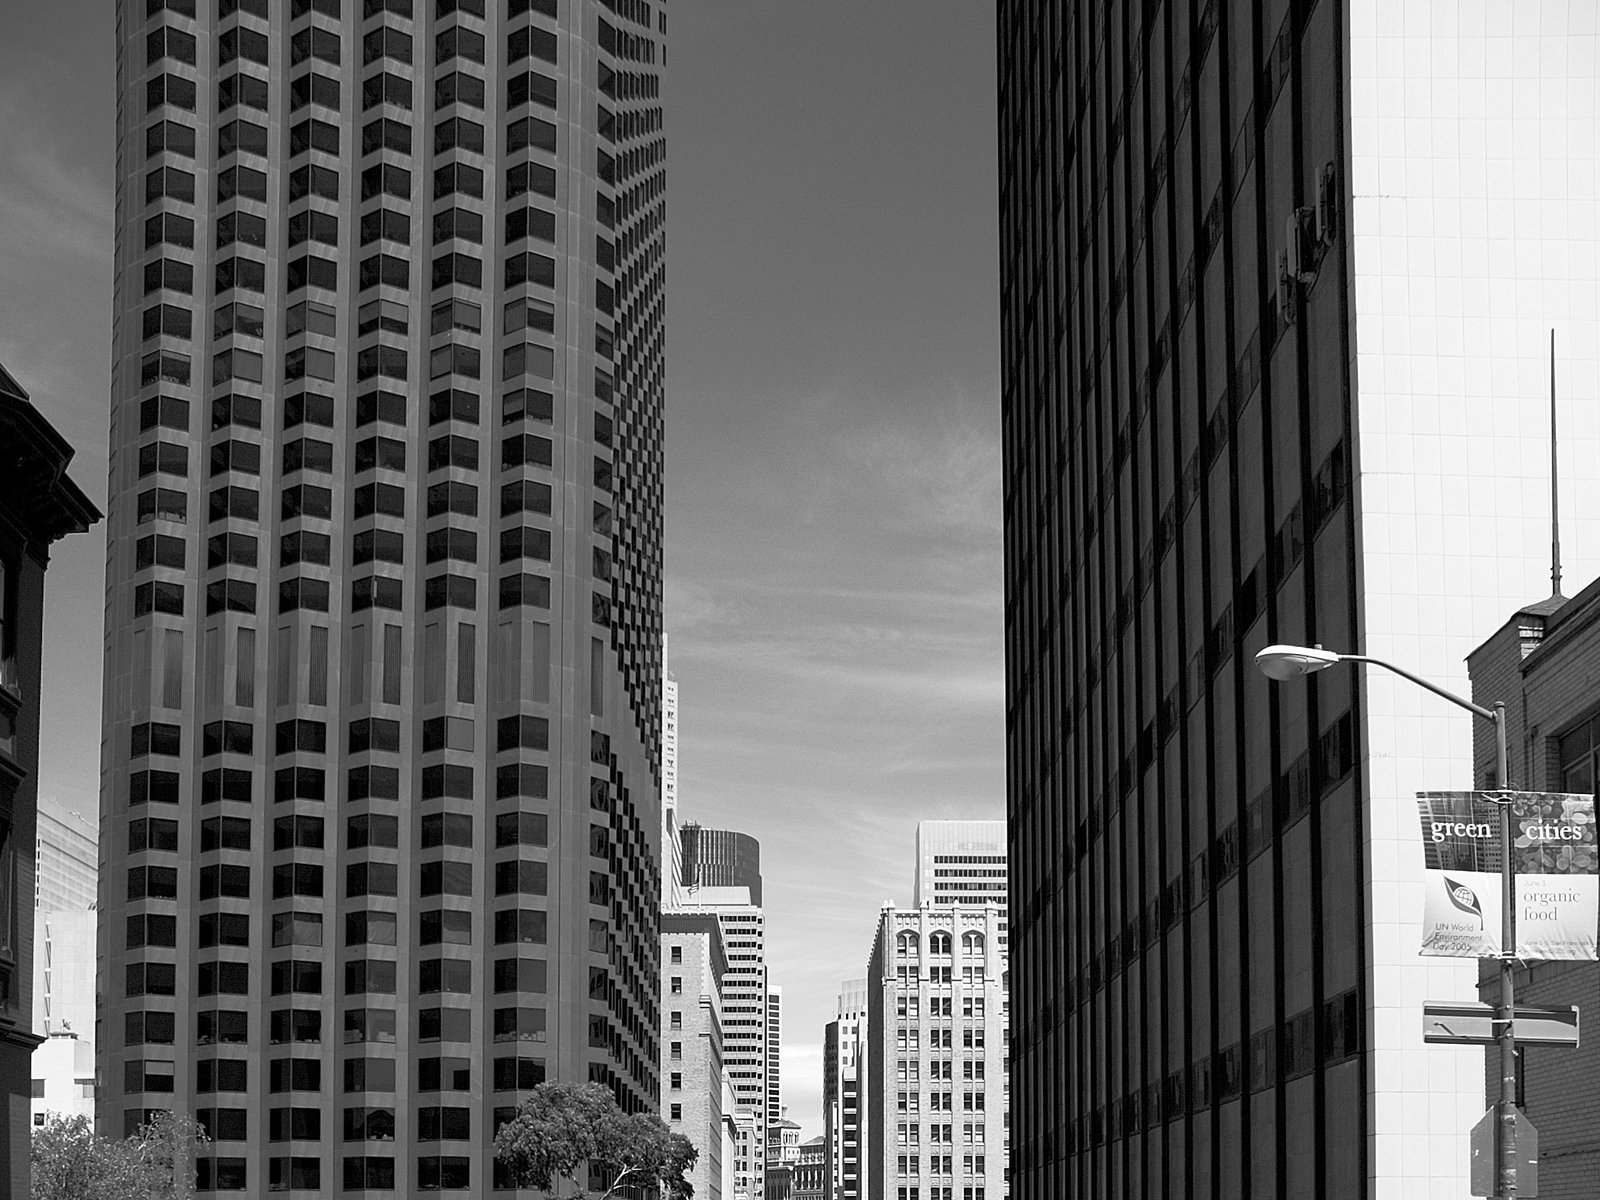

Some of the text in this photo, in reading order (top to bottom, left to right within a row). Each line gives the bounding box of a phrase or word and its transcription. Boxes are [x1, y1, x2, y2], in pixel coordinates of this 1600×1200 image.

[1431, 819, 1582, 843] green cities
[1523, 888, 1580, 906] organic
[1524, 906, 1557, 921] food
[1435, 922, 1474, 932] UN World
[1434, 932, 1482, 942] Environment
[1432, 941, 1472, 951] Day 2005
